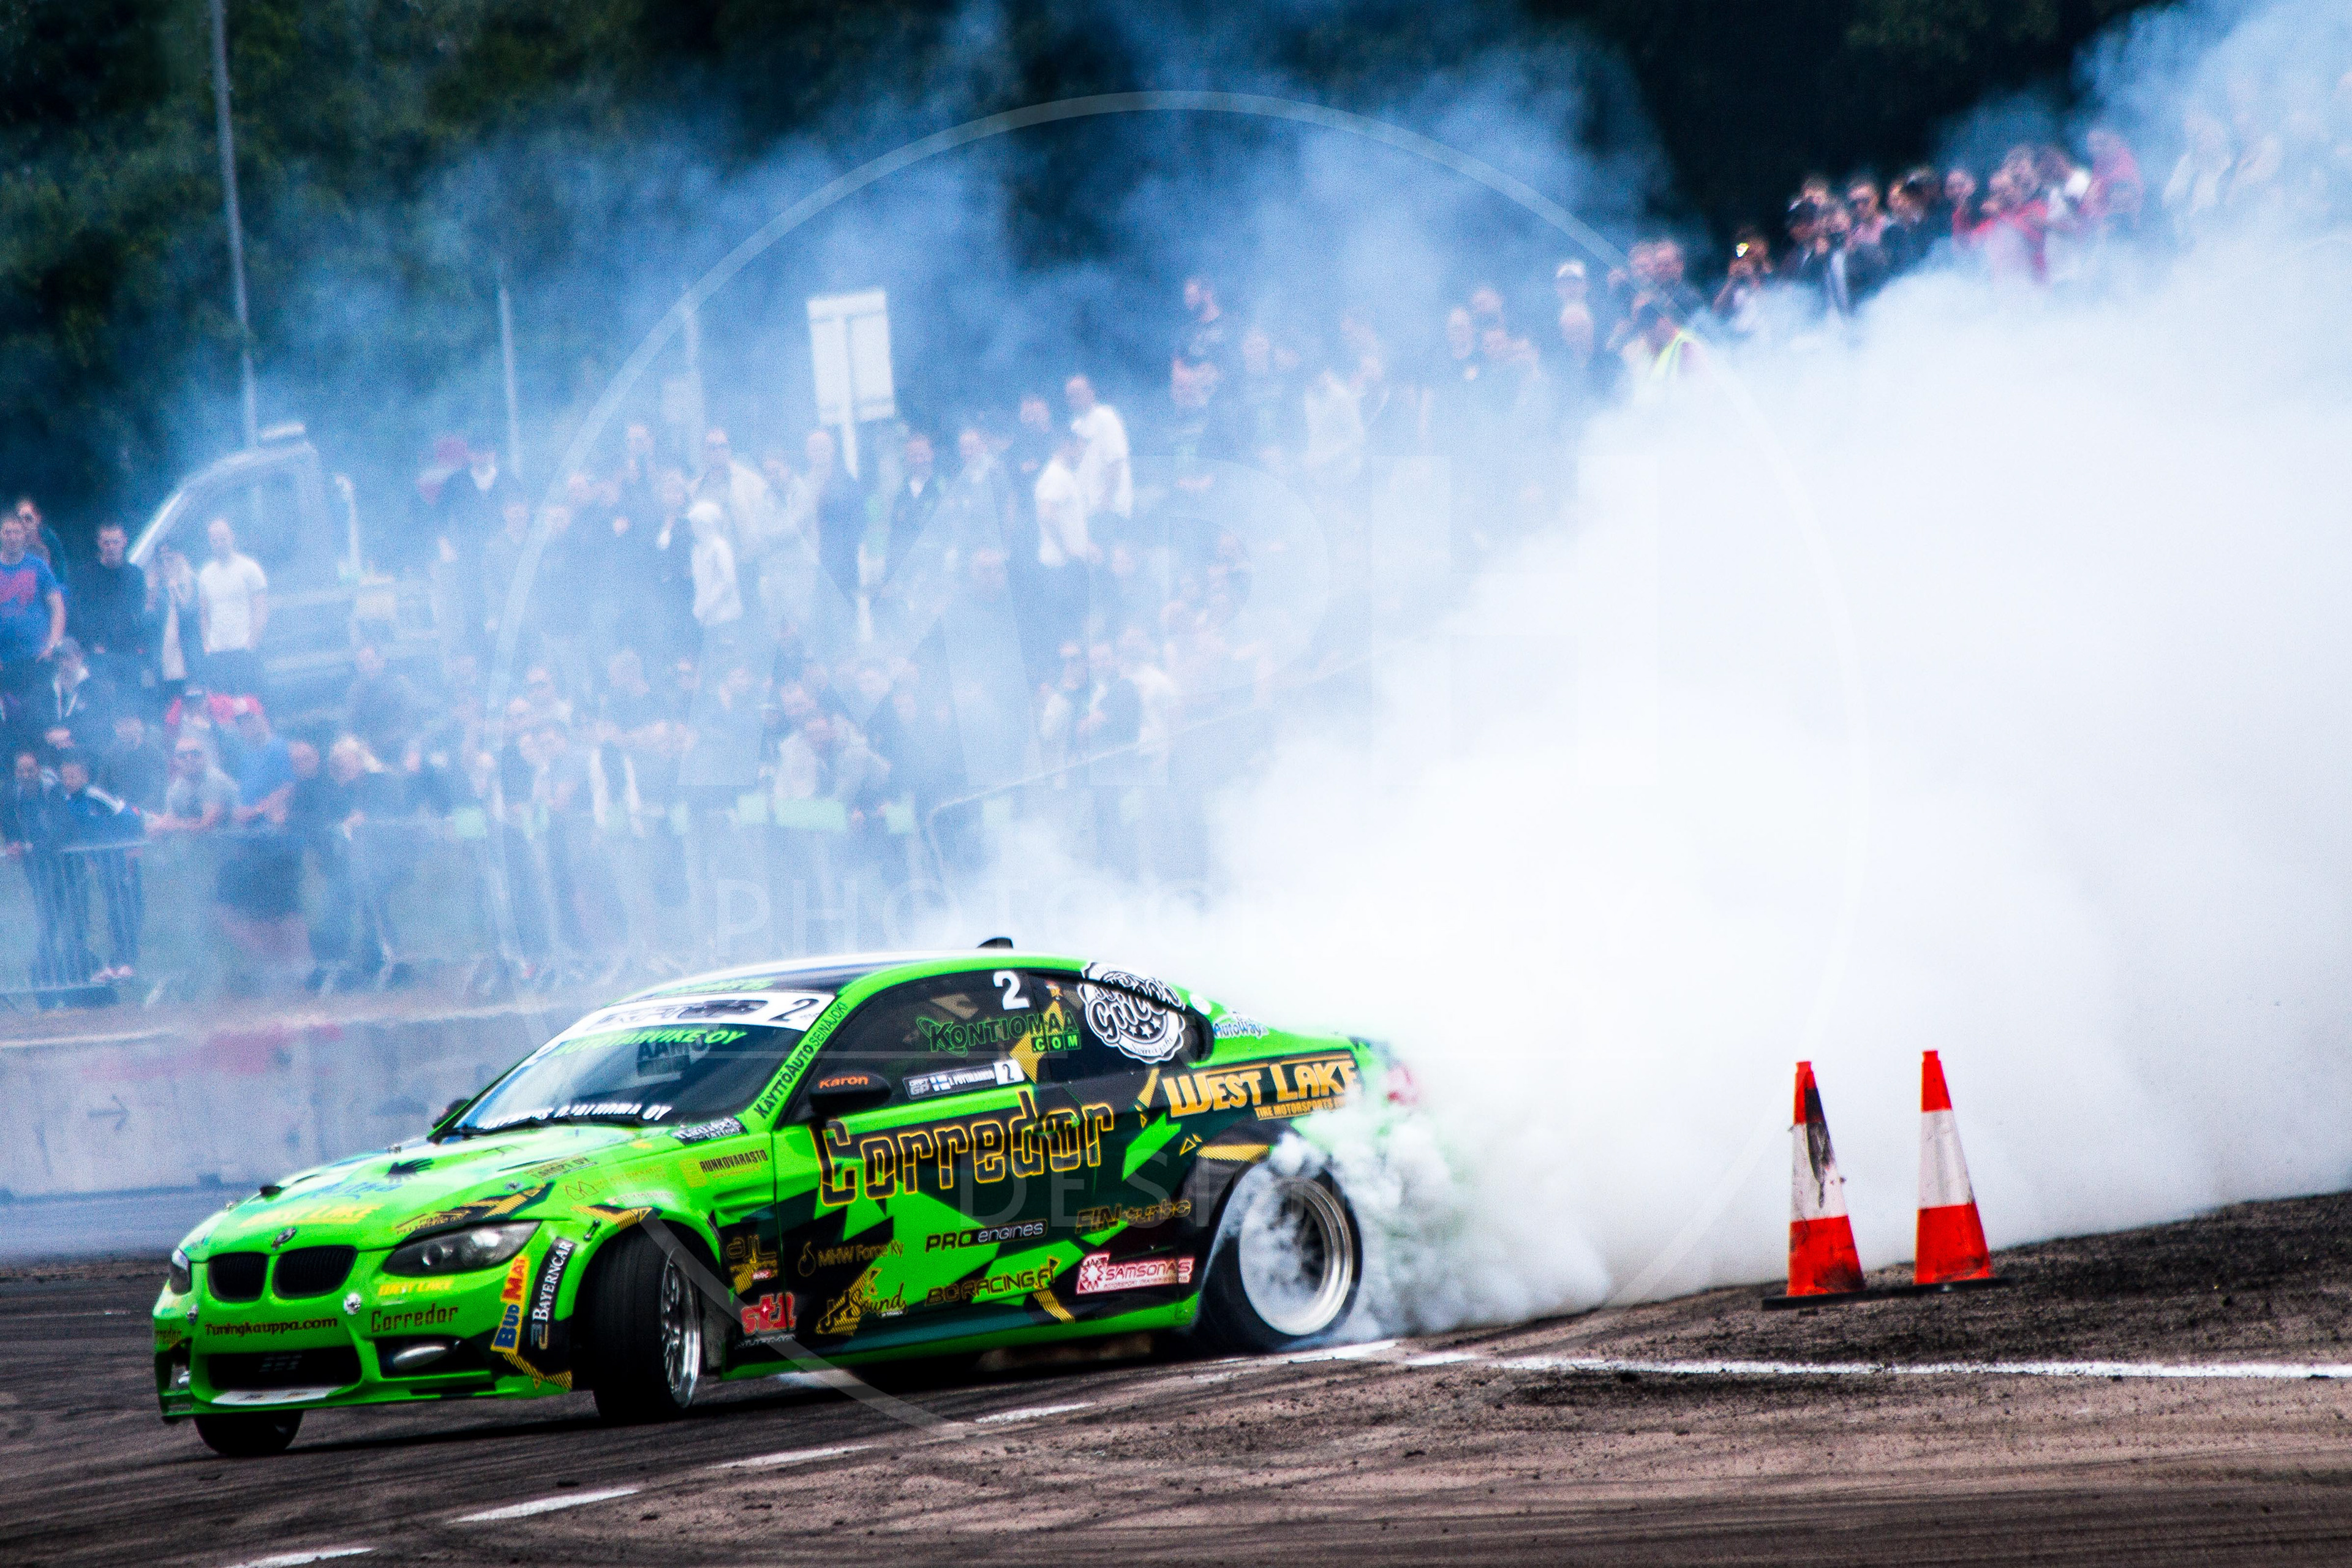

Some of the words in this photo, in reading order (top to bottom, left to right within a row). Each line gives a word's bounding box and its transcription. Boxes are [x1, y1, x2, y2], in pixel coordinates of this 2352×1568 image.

[993, 970, 1030, 1011] 2
[767, 998, 819, 1022] 2
[704, 1029, 748, 1045] OY
[927, 1010, 1080, 1053] KONTIOMAA
[753, 1044, 814, 1119] KÄYTTÖAUTO
[809, 1001, 848, 1046] SEINÄJOKI
[1002, 1063, 1015, 1081] 2
[818, 1075, 869, 1089] Karon
[1164, 1071, 1262, 1118] WEST
[643, 1104, 673, 1121] OY
[809, 1090, 1115, 1207] Corredor
[699, 1149, 769, 1174] RUNKOVARASTO
[533, 1241, 573, 1322] BAYERNCAR
[1105, 1261, 1191, 1281] SAMSONAS
[205, 1317, 338, 1337] Tuningkauppa.com
[371, 1302, 458, 1333] Corredor
